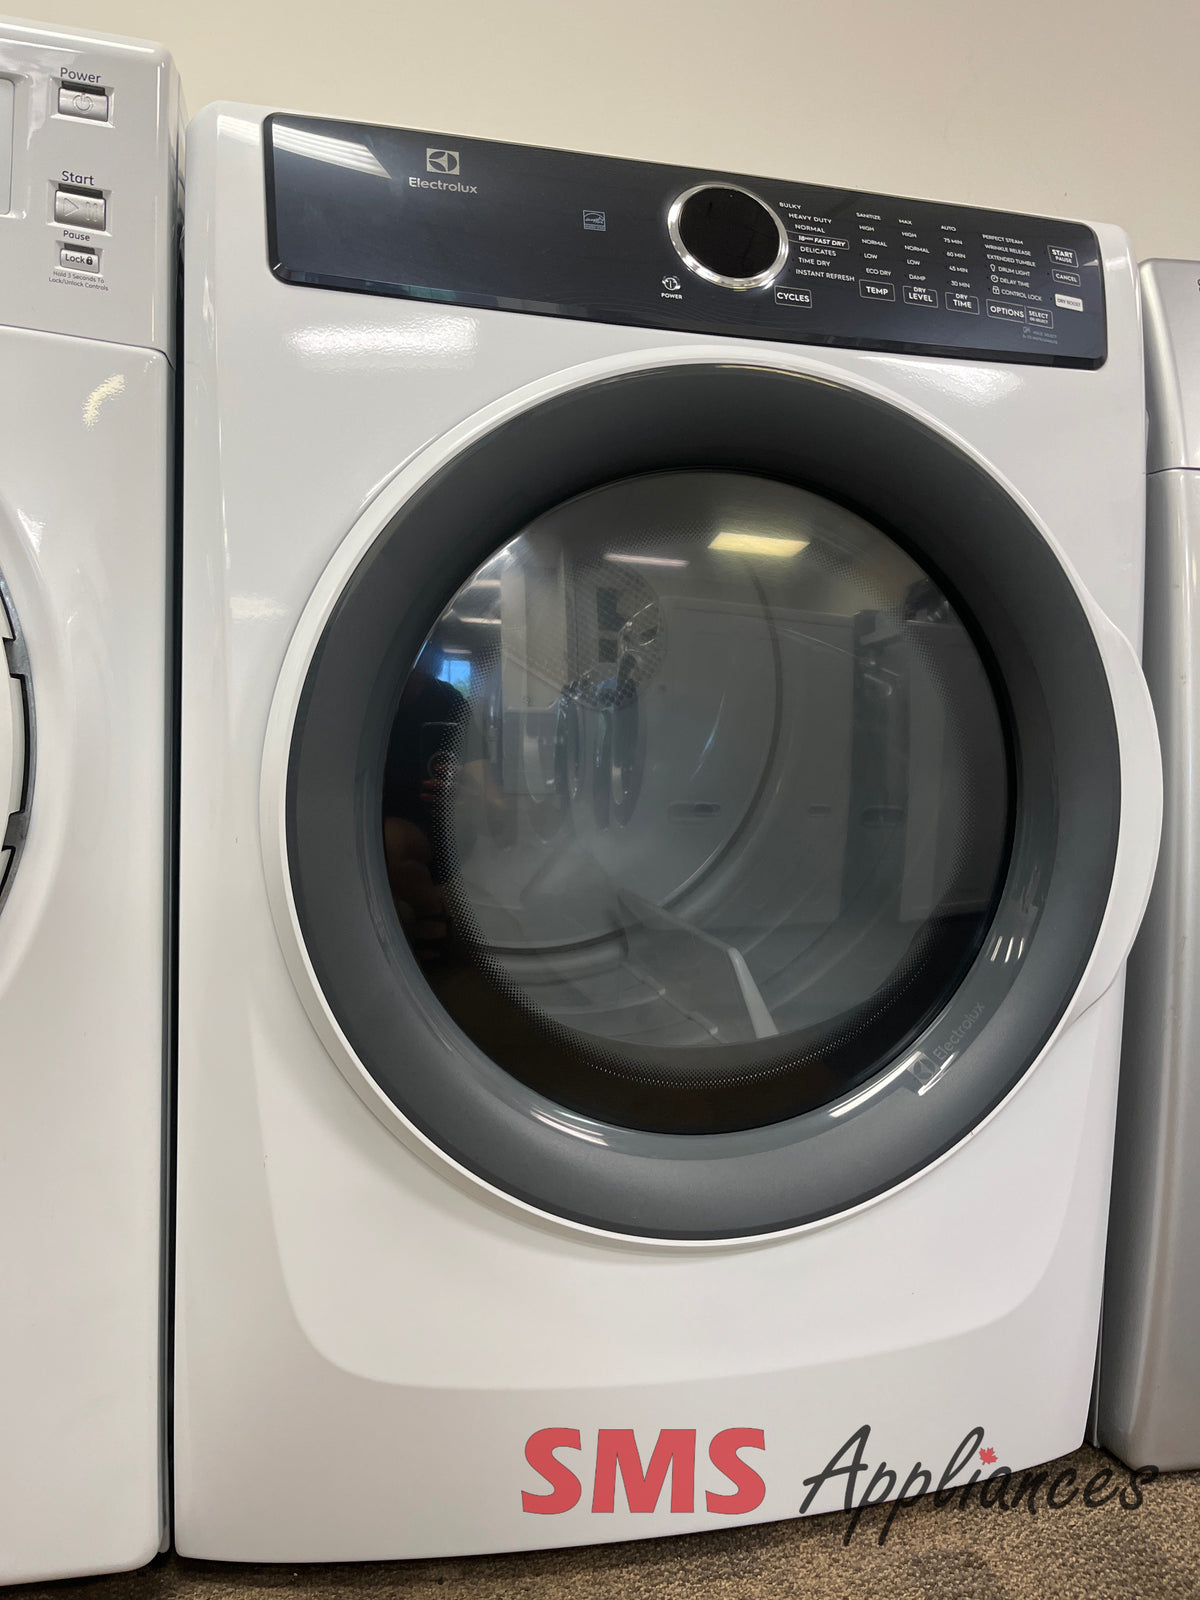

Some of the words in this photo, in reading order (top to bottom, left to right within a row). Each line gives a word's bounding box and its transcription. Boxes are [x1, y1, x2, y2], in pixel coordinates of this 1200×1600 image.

[60, 66, 101, 83] Power
[61, 170, 95, 186] Start
[408, 176, 478, 194] Electrolux
[779, 202, 802, 210] BULKY
[788, 212, 812, 221] HEAVY
[813, 216, 832, 224] DUTY
[856, 212, 881, 221] SANITIZE
[795, 223, 826, 234] NORMAL
[859, 224, 875, 232] HIGH
[63, 229, 91, 242] Pause
[814, 237, 830, 245] FAST
[982, 234, 1004, 242] PERFECT
[1005, 237, 1024, 245] STEAM
[861, 238, 888, 248] NORMAL
[800, 246, 837, 257] DELICATES
[904, 245, 930, 254] NORMAL
[984, 244, 1009, 253] WRINKLE
[1009, 248, 1032, 257] RELEASE
[1051, 249, 1073, 258] START
[65, 253, 86, 264] Lock
[798, 256, 815, 265] TIME
[986, 254, 1015, 264] EXTENDED
[1015, 258, 1036, 267] TUMBLE
[1055, 256, 1073, 264] PAUSE
[795, 268, 825, 278] INSTANT
[825, 272, 855, 282] REFRESH
[865, 267, 879, 275] ECO
[998, 266, 1016, 274] DRUM
[1015, 269, 1031, 277] LIGHT
[72, 273, 97, 282] Seconds
[908, 273, 926, 281] DAMP
[999, 277, 1017, 286] DELAY
[1017, 280, 1031, 288] TIME
[1055, 273, 1078, 282] CANCEL
[48, 277, 84, 287] Lock/Unlock
[84, 282, 109, 291] Controls
[660, 292, 683, 300] POWER
[865, 285, 889, 296] TEMP
[1001, 288, 1028, 299] CONTROL
[1027, 293, 1043, 301] LOCK
[776, 292, 810, 303] CYCLES
[908, 292, 934, 303] LEVEL
[952, 298, 973, 309] TIME
[989, 305, 1025, 318] OPTIONS
[1028, 310, 1048, 318] SELECT
[932, 1001, 986, 1061] Electrolux
